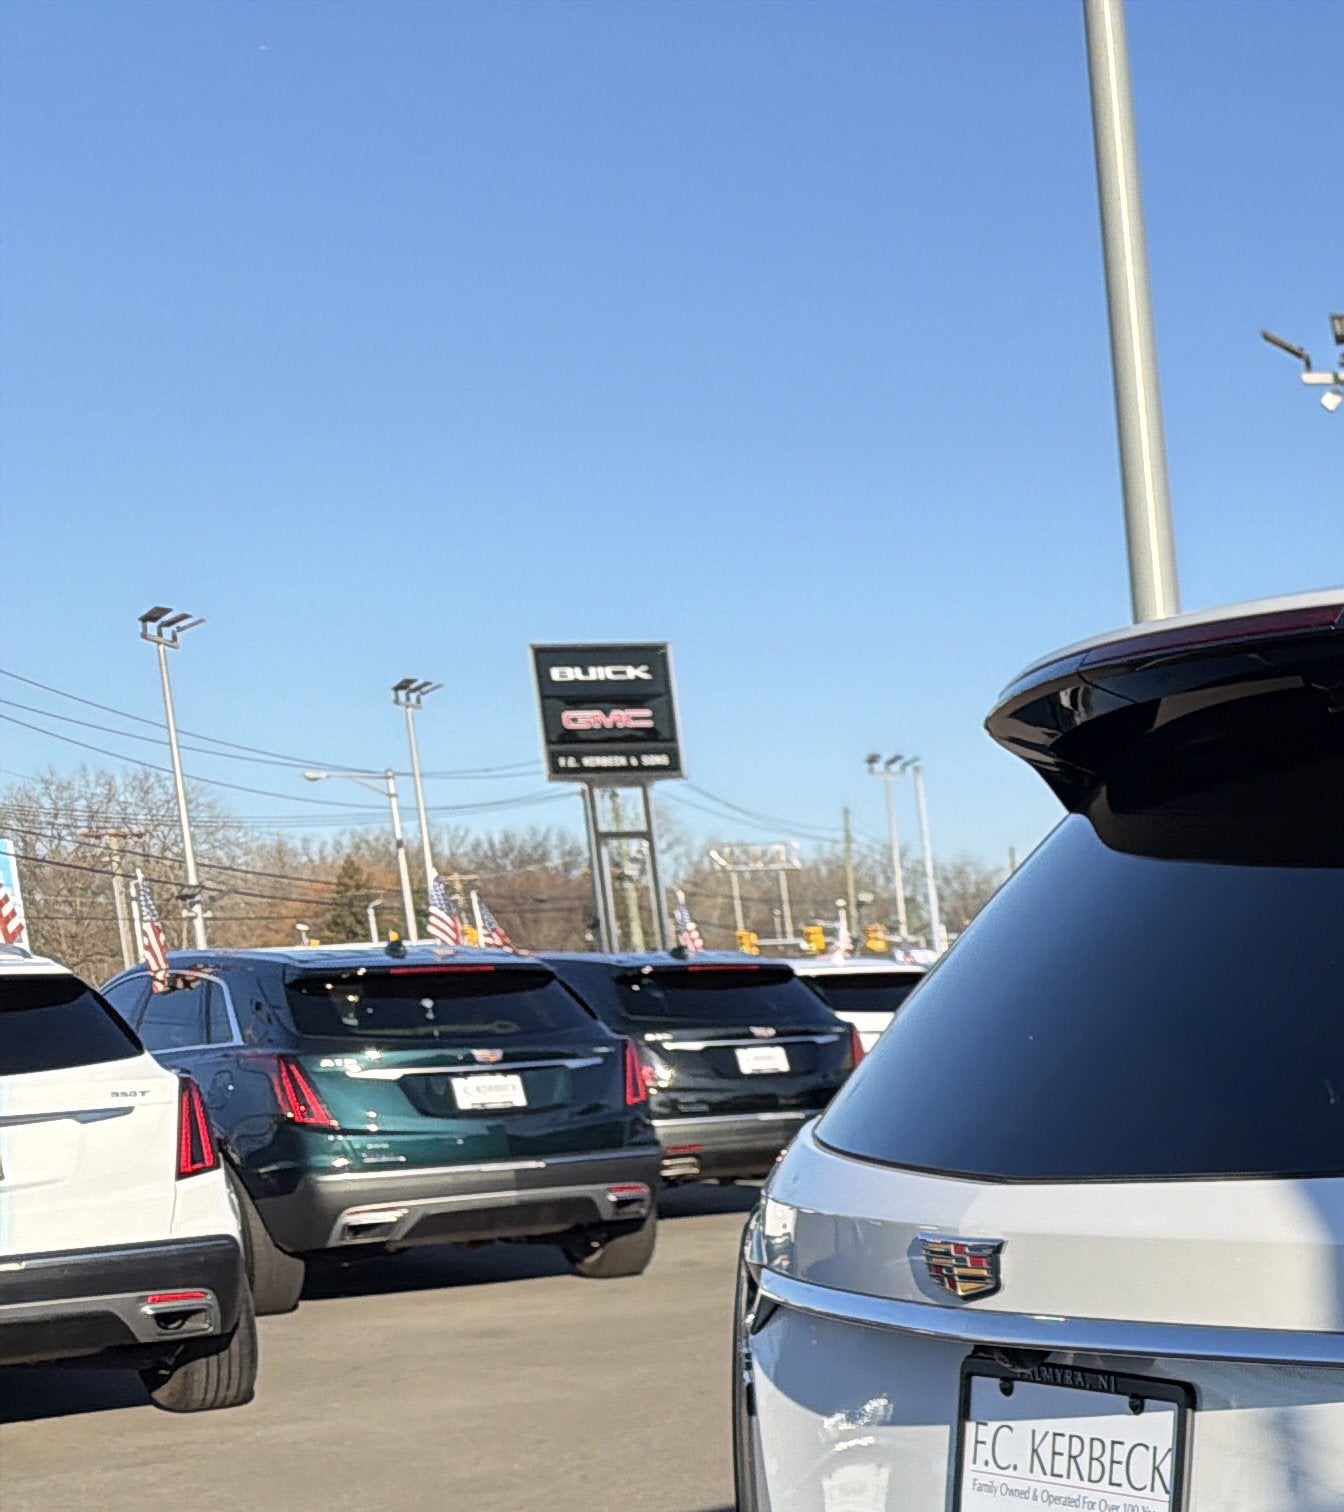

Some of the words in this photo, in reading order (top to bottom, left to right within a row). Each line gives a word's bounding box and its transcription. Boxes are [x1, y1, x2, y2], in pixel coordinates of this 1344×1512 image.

[550, 664, 653, 681] BUICK
[561, 708, 654, 730] GMC
[971, 1421, 1018, 1472] F.C.
[1029, 1428, 1173, 1495] KERBECK
[972, 1478, 999, 1496] Family
[1000, 1483, 1031, 1501] Owned
[1032, 1489, 1039, 1501] &
[1041, 1489, 1081, 1510] Operated
[1082, 1498, 1096, 1511] For
